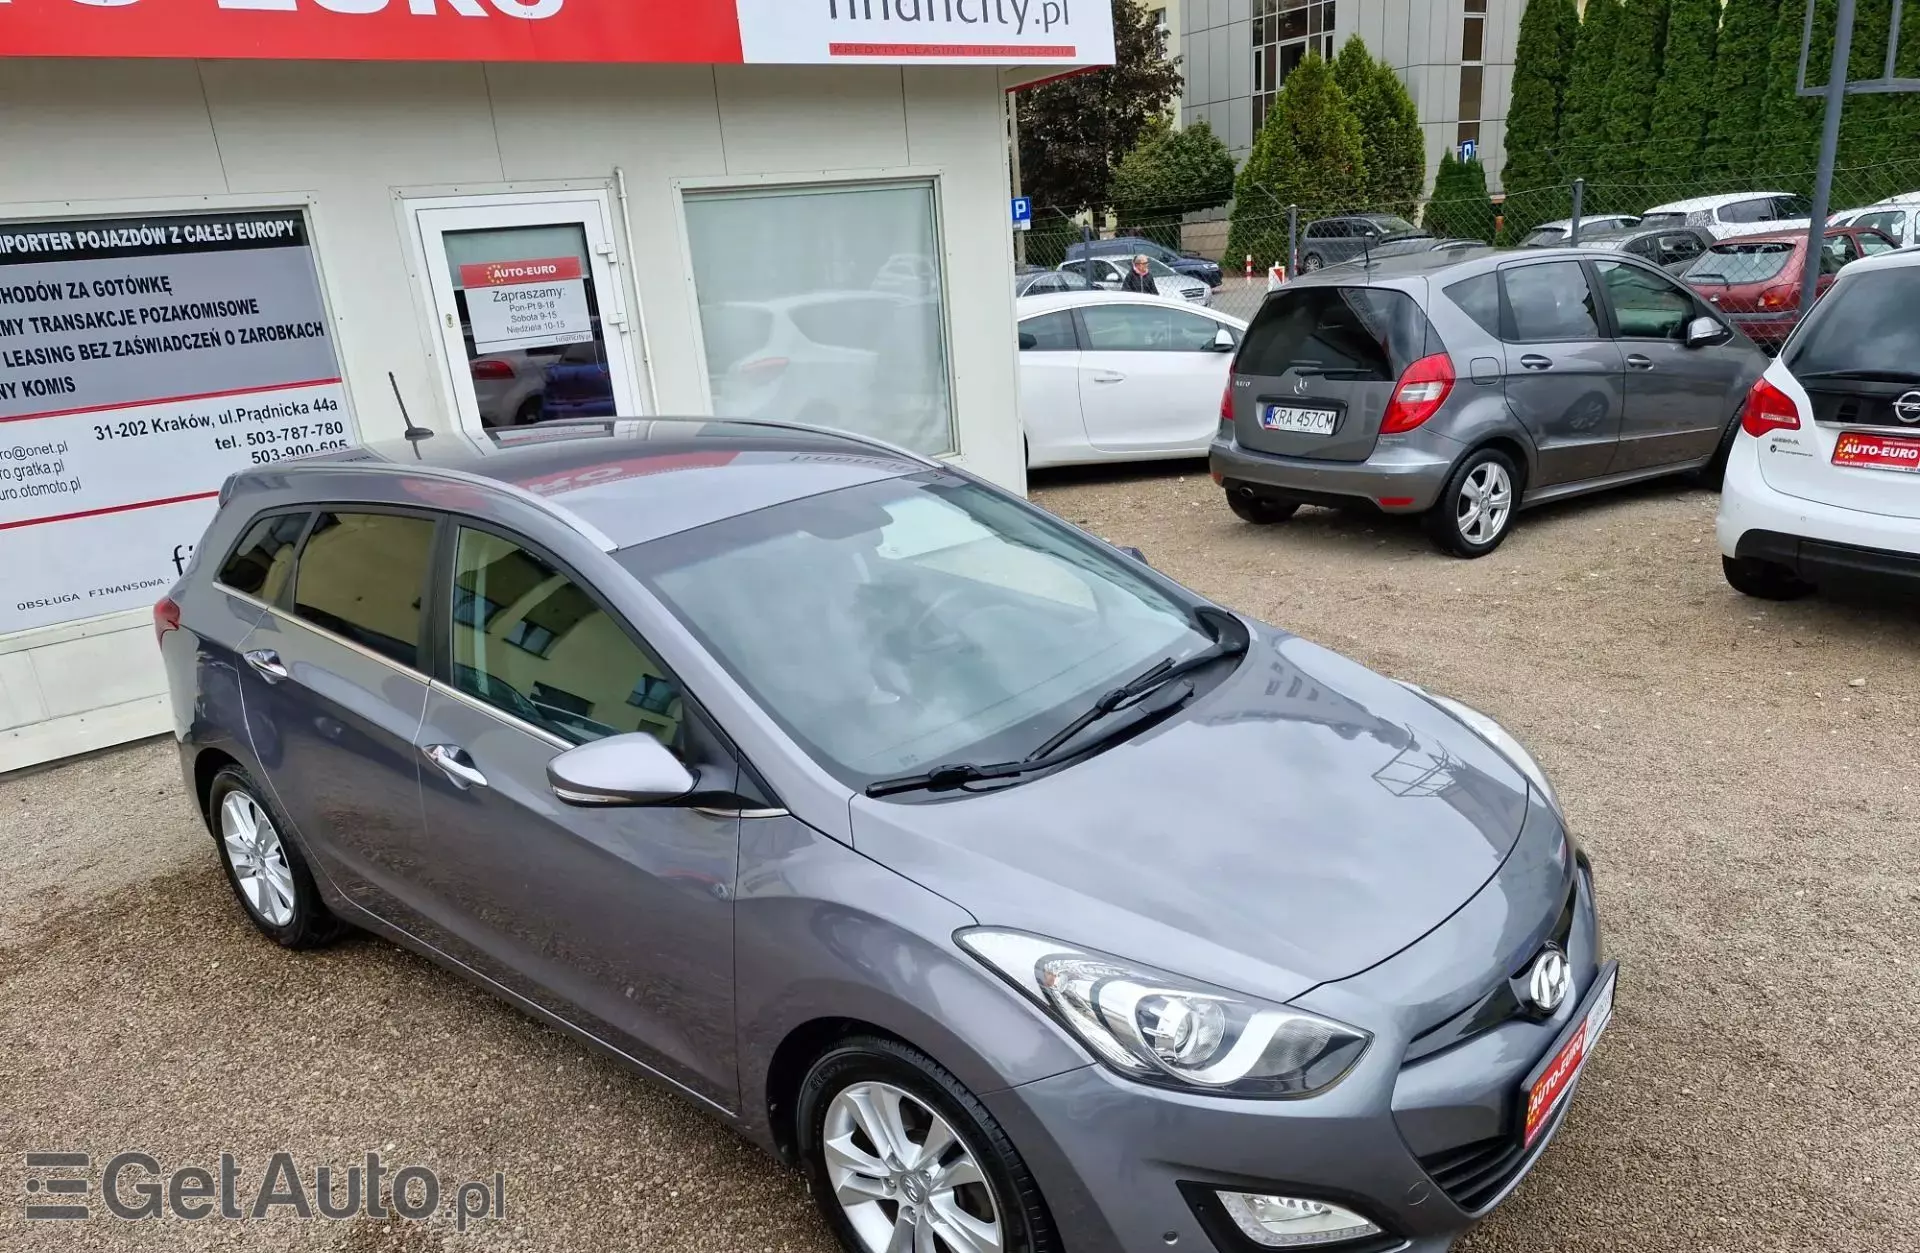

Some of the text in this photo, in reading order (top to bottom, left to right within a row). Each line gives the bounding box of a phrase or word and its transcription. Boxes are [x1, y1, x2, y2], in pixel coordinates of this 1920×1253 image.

[76, 224, 166, 249] POJAZDÓW
[168, 228, 181, 244] Z
[184, 223, 233, 242] CAŁEJ
[235, 220, 295, 239] EUROPY
[493, 264, 557, 278] AUTO-EURO
[0, 274, 173, 304] HODÓW ZA GOTÓWKĘ
[492, 287, 566, 303] Zapraszamy:
[28, 309, 137, 334] TRANSAKCJE
[139, 298, 260, 324] POZAKOMISOWE
[509, 301, 555, 313] Pon-Pt 9-18
[540, 311, 557, 321] 9-15
[544, 321, 566, 331] 10-15
[3, 321, 325, 368] LEASING BEZ ZAŚWIADCZEŃ O ZAROBKACH
[22, 376, 76, 397] KOMIS
[94, 398, 338, 441] 31-202 Kraków, ul.Prądnicka 44a
[1271, 409, 1334, 428] KRA 457CM
[215, 421, 344, 451] tel. 503-787-780
[1843, 443, 1918, 459] AUTO-EURO
[17, 577, 171, 611] OBSŁUGA FINANSOWA:
